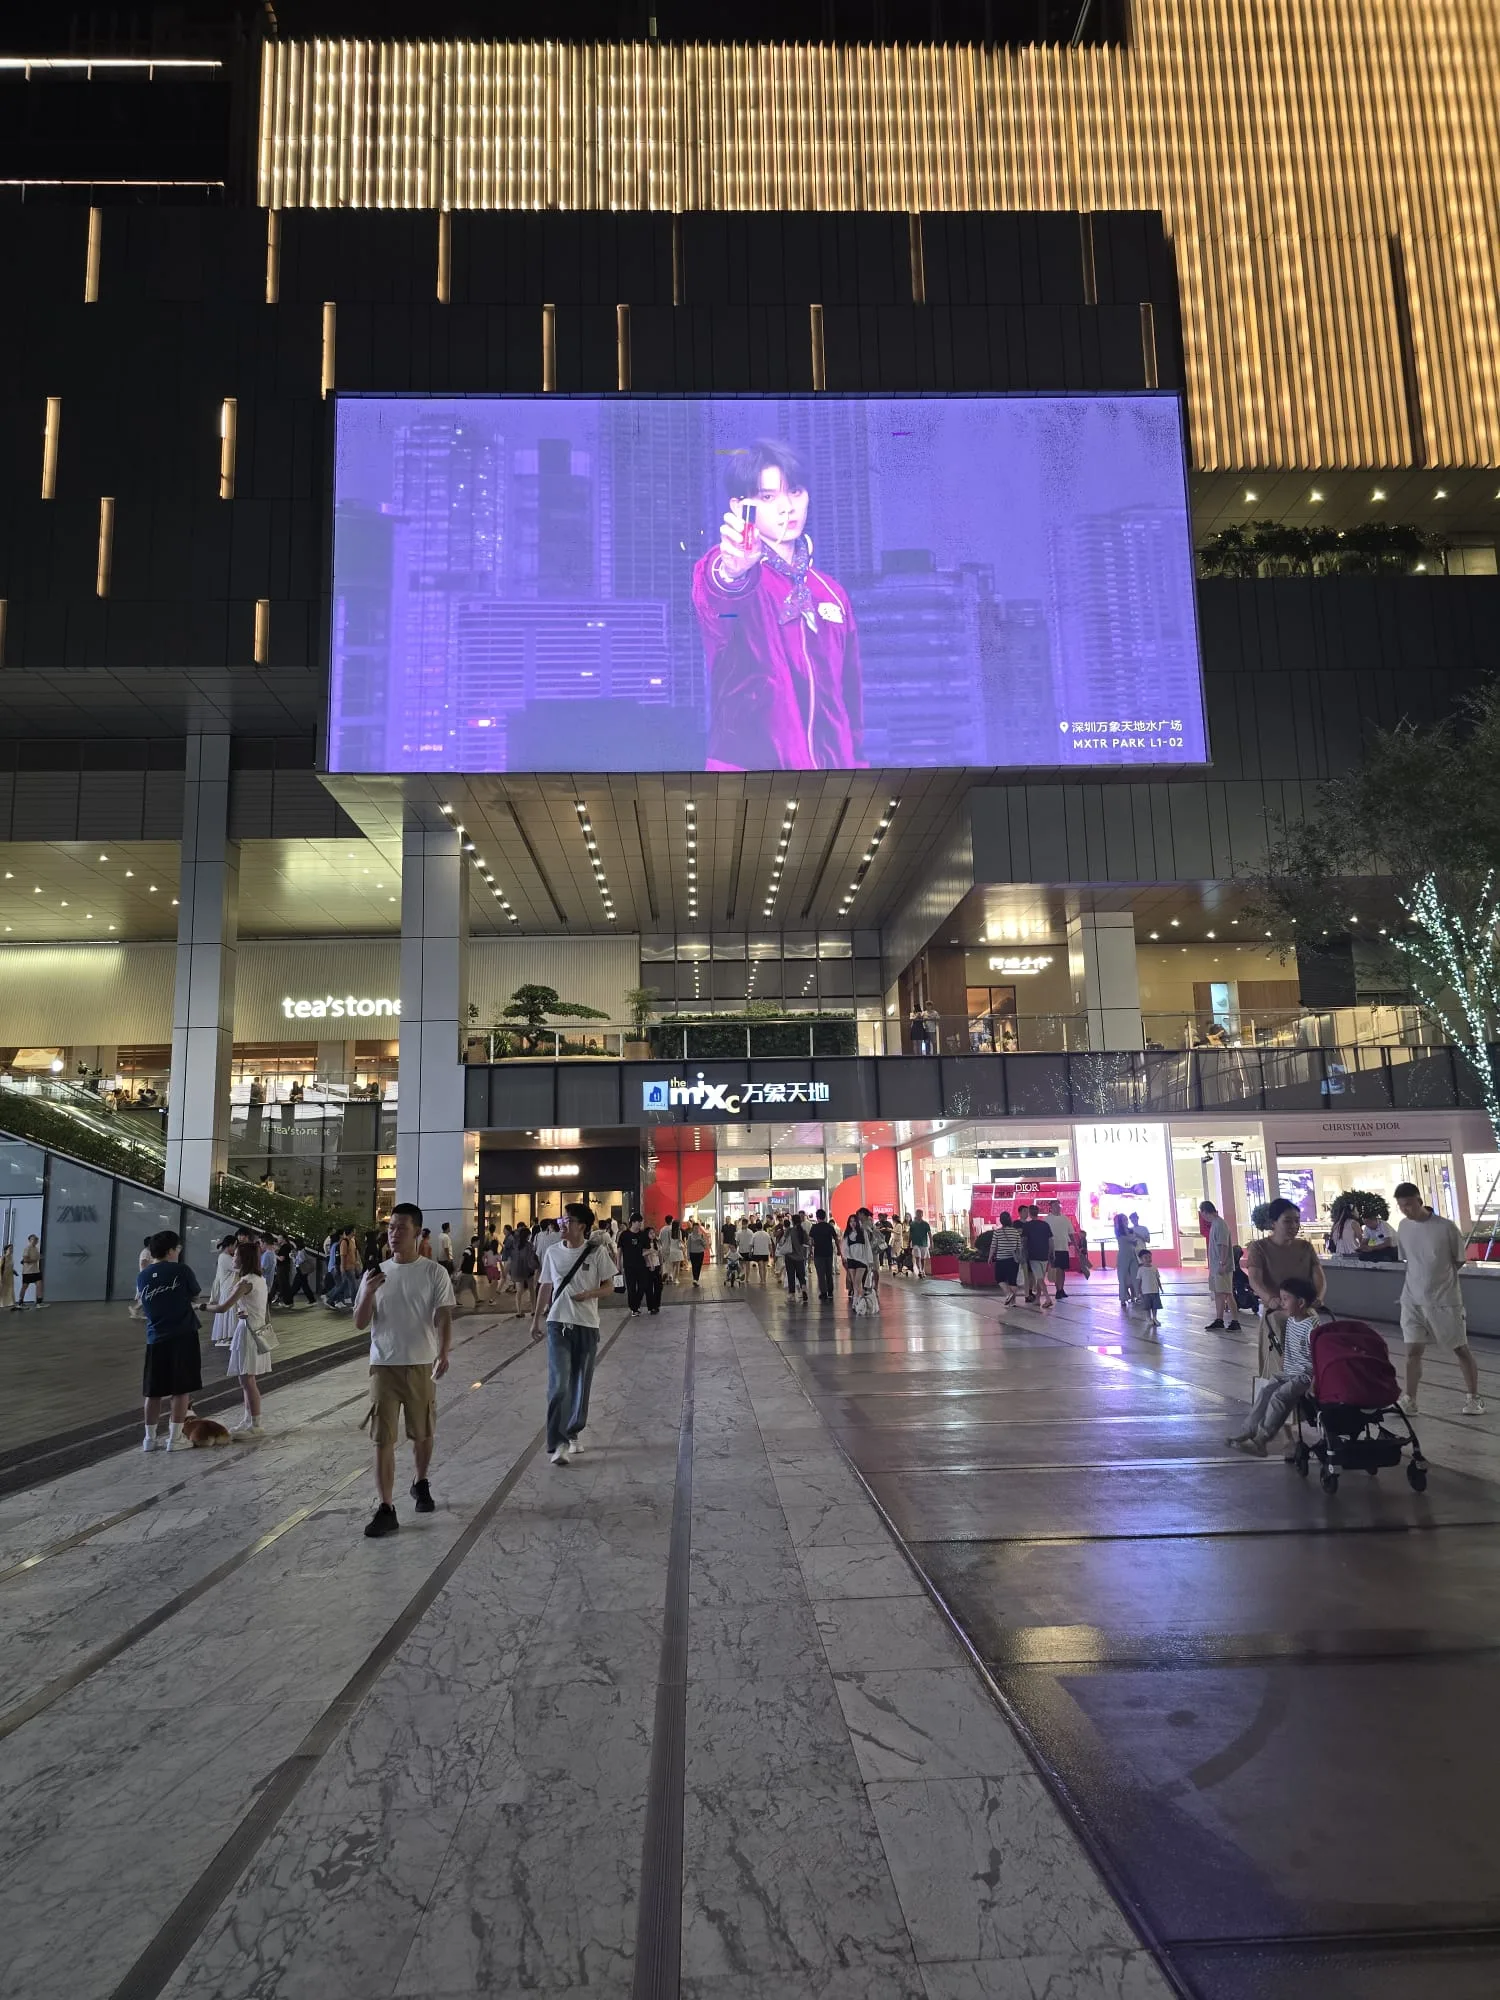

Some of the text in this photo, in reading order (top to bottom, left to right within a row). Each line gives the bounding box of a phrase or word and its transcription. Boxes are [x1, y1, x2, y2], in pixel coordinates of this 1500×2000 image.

[1072, 720, 1183, 733] 深圳万象天地水广场
[1073, 738, 1183, 748] MXTR PARK L1-02
[670, 1077, 687, 1088] the
[741, 1082, 830, 1103] 万象天地
[1322, 1122, 1400, 1131] CHRISTIAN DIOR
[1094, 1127, 1148, 1144] DIOR
[1015, 1183, 1039, 1192] DIOR
